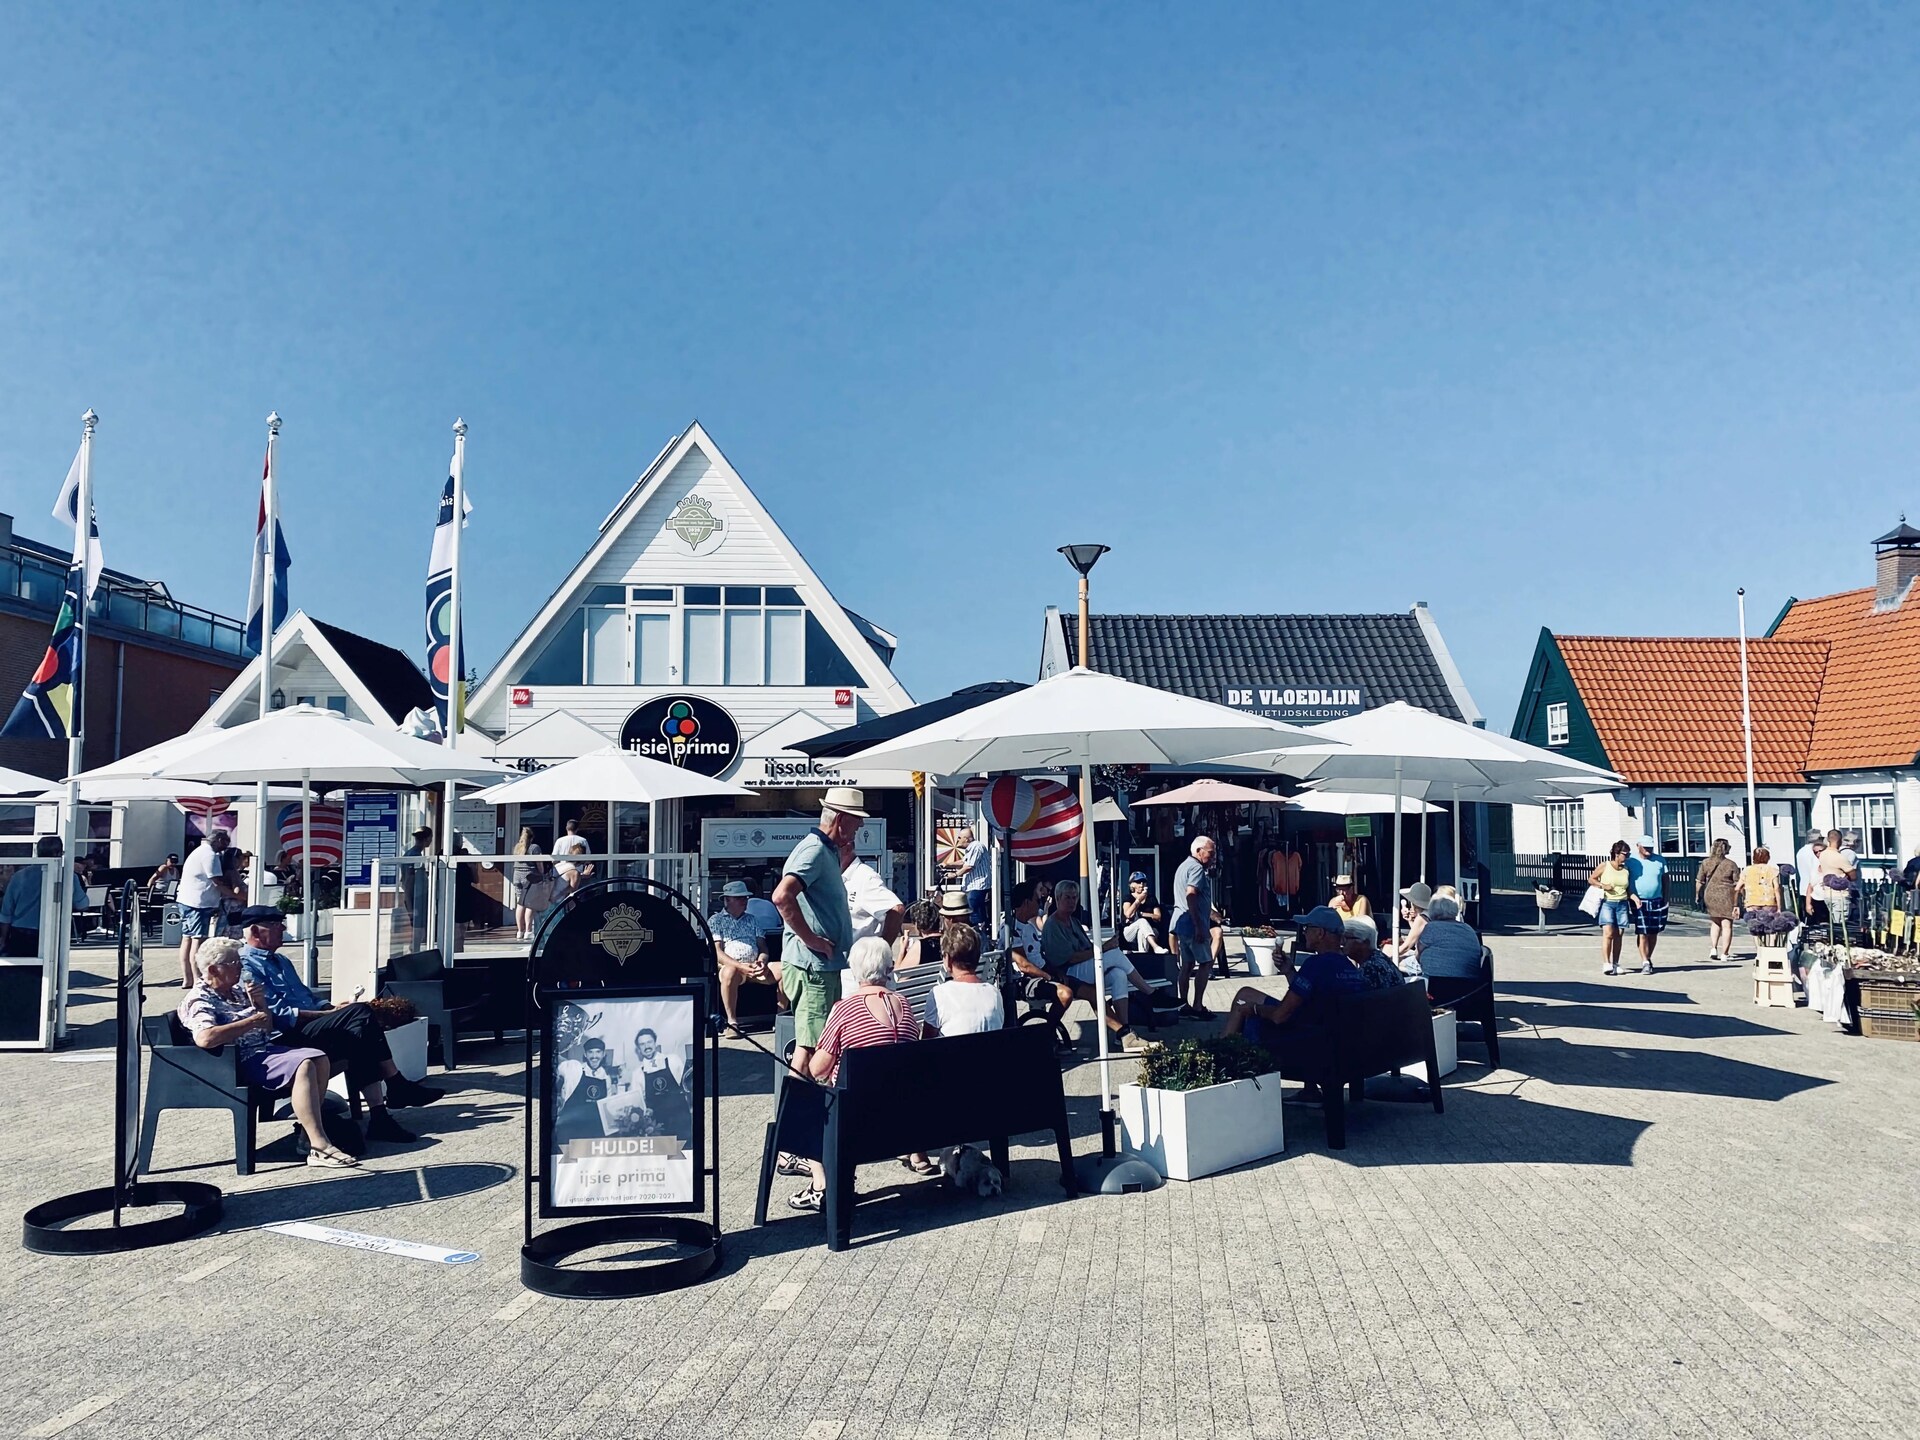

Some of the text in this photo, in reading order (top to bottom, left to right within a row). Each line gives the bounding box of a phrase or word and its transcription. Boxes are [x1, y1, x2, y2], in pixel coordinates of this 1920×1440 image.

[513, 690, 529, 704] illy
[835, 691, 850, 704] illy
[1227, 689, 1361, 705] DE VLOEDLIJN
[674, 738, 730, 758] prima
[591, 1139, 654, 1156] HULDE!
[580, 1168, 666, 1188] ijsie prima
